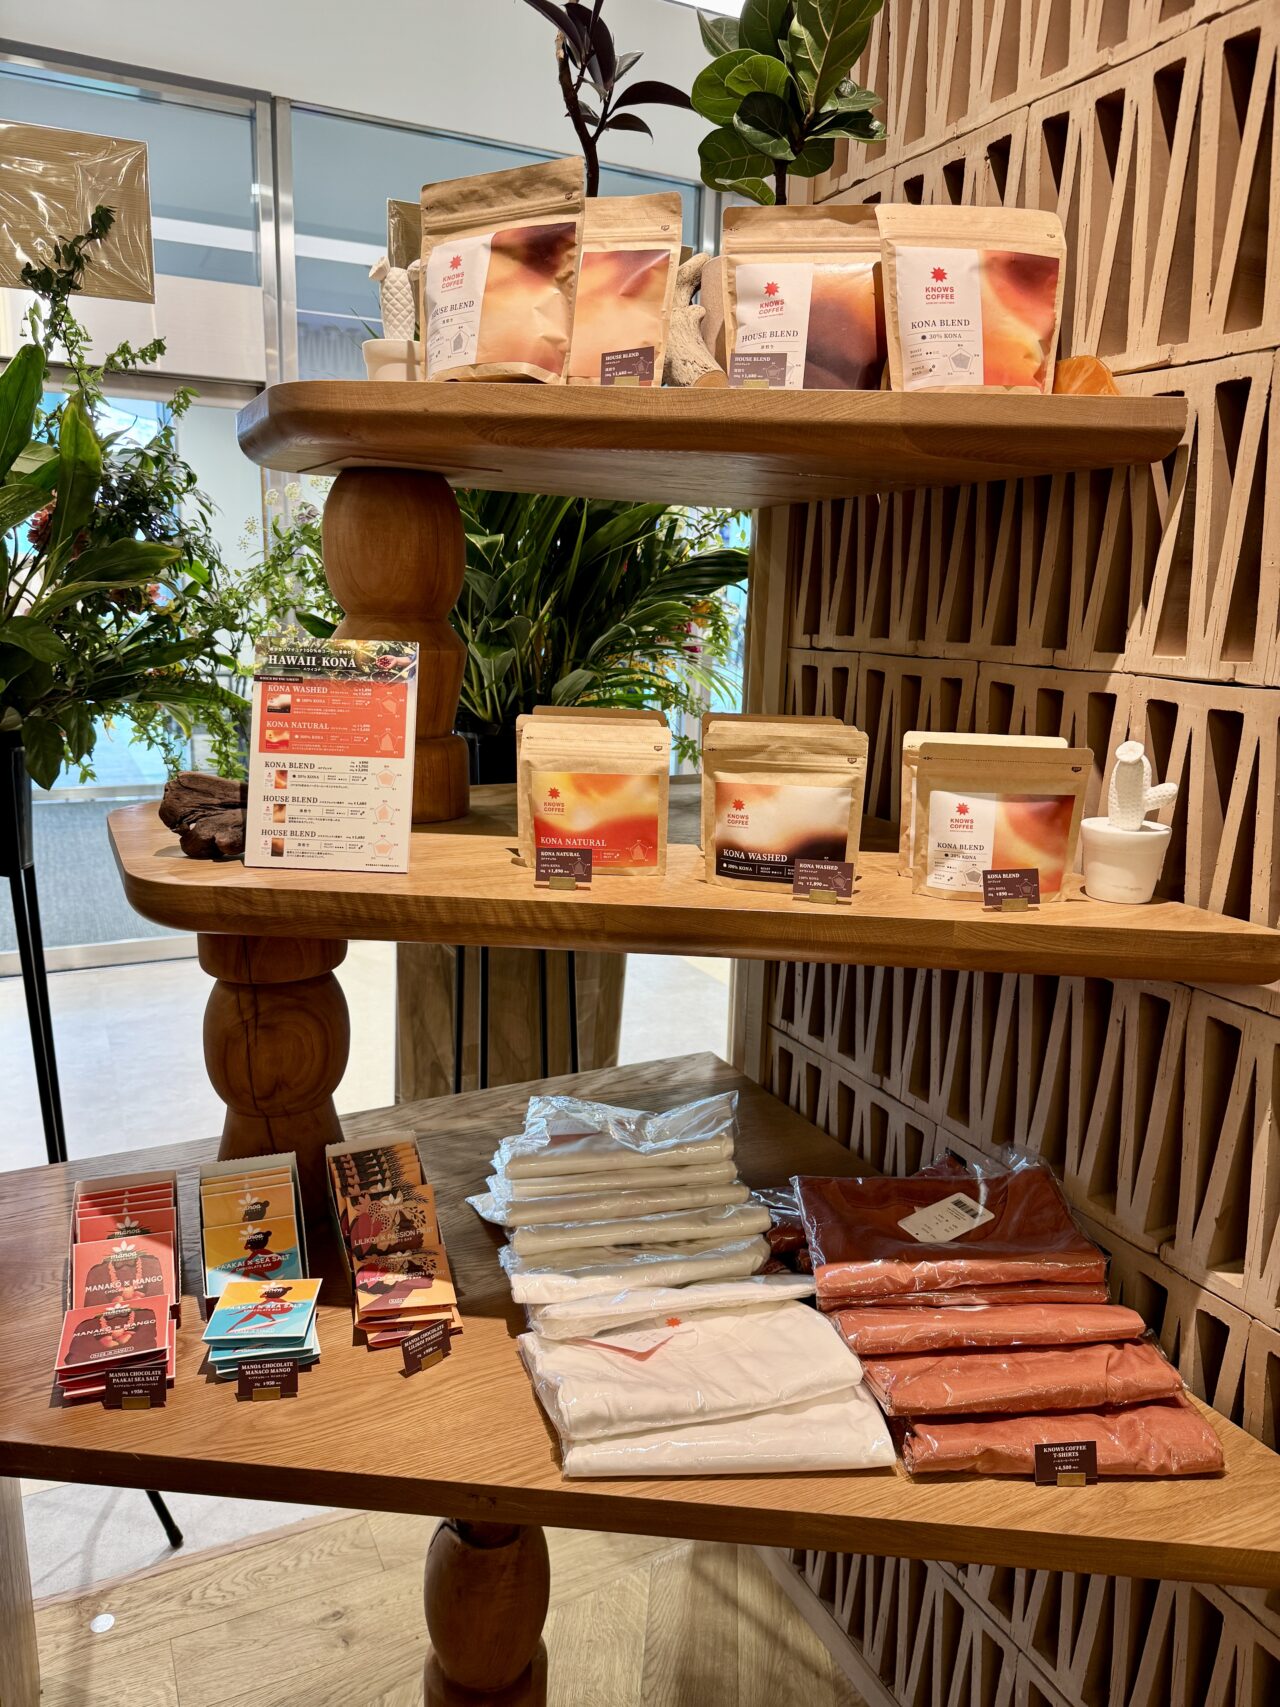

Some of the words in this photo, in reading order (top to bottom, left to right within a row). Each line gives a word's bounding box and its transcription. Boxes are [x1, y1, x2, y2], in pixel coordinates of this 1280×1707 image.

[442, 272, 465, 282] KNOWS
[441, 279, 464, 289] COFFEE
[449, 300, 475, 312] BLEND
[759, 299, 785, 309] KNOWS
[758, 306, 784, 315] COFFEE
[911, 319, 937, 330] KONA
[939, 318, 970, 327] BLEND
[741, 331, 768, 343] HOUSE
[769, 329, 799, 338] BLEND
[268, 654, 316, 666] HAWAII
[321, 656, 357, 668] KONA
[267, 684, 290, 692] KONA
[292, 685, 328, 694] WASHED
[266, 720, 289, 728] KONA
[291, 721, 330, 730] NATURAL
[264, 761, 287, 769] KONA
[288, 761, 316, 769] BLEND
[263, 795, 290, 803] HOUSE
[291, 796, 318, 804] BLEND
[261, 829, 288, 837] HOUSE
[289, 830, 317, 838] BLEND
[540, 837, 563, 846] KONA
[565, 838, 607, 847] NATURAL
[937, 842, 957, 850] KONA
[959, 843, 985, 851] BLEND
[723, 849, 745, 860] KONA
[747, 852, 788, 863] WASHED
[255, 1257, 271, 1265] SEA
[271, 1253, 291, 1262] SALT
[132, 1275, 163, 1287] MANGO
[123, 1319, 157, 1329] MANGO
[262, 1361, 294, 1369] CHOCOLATE
